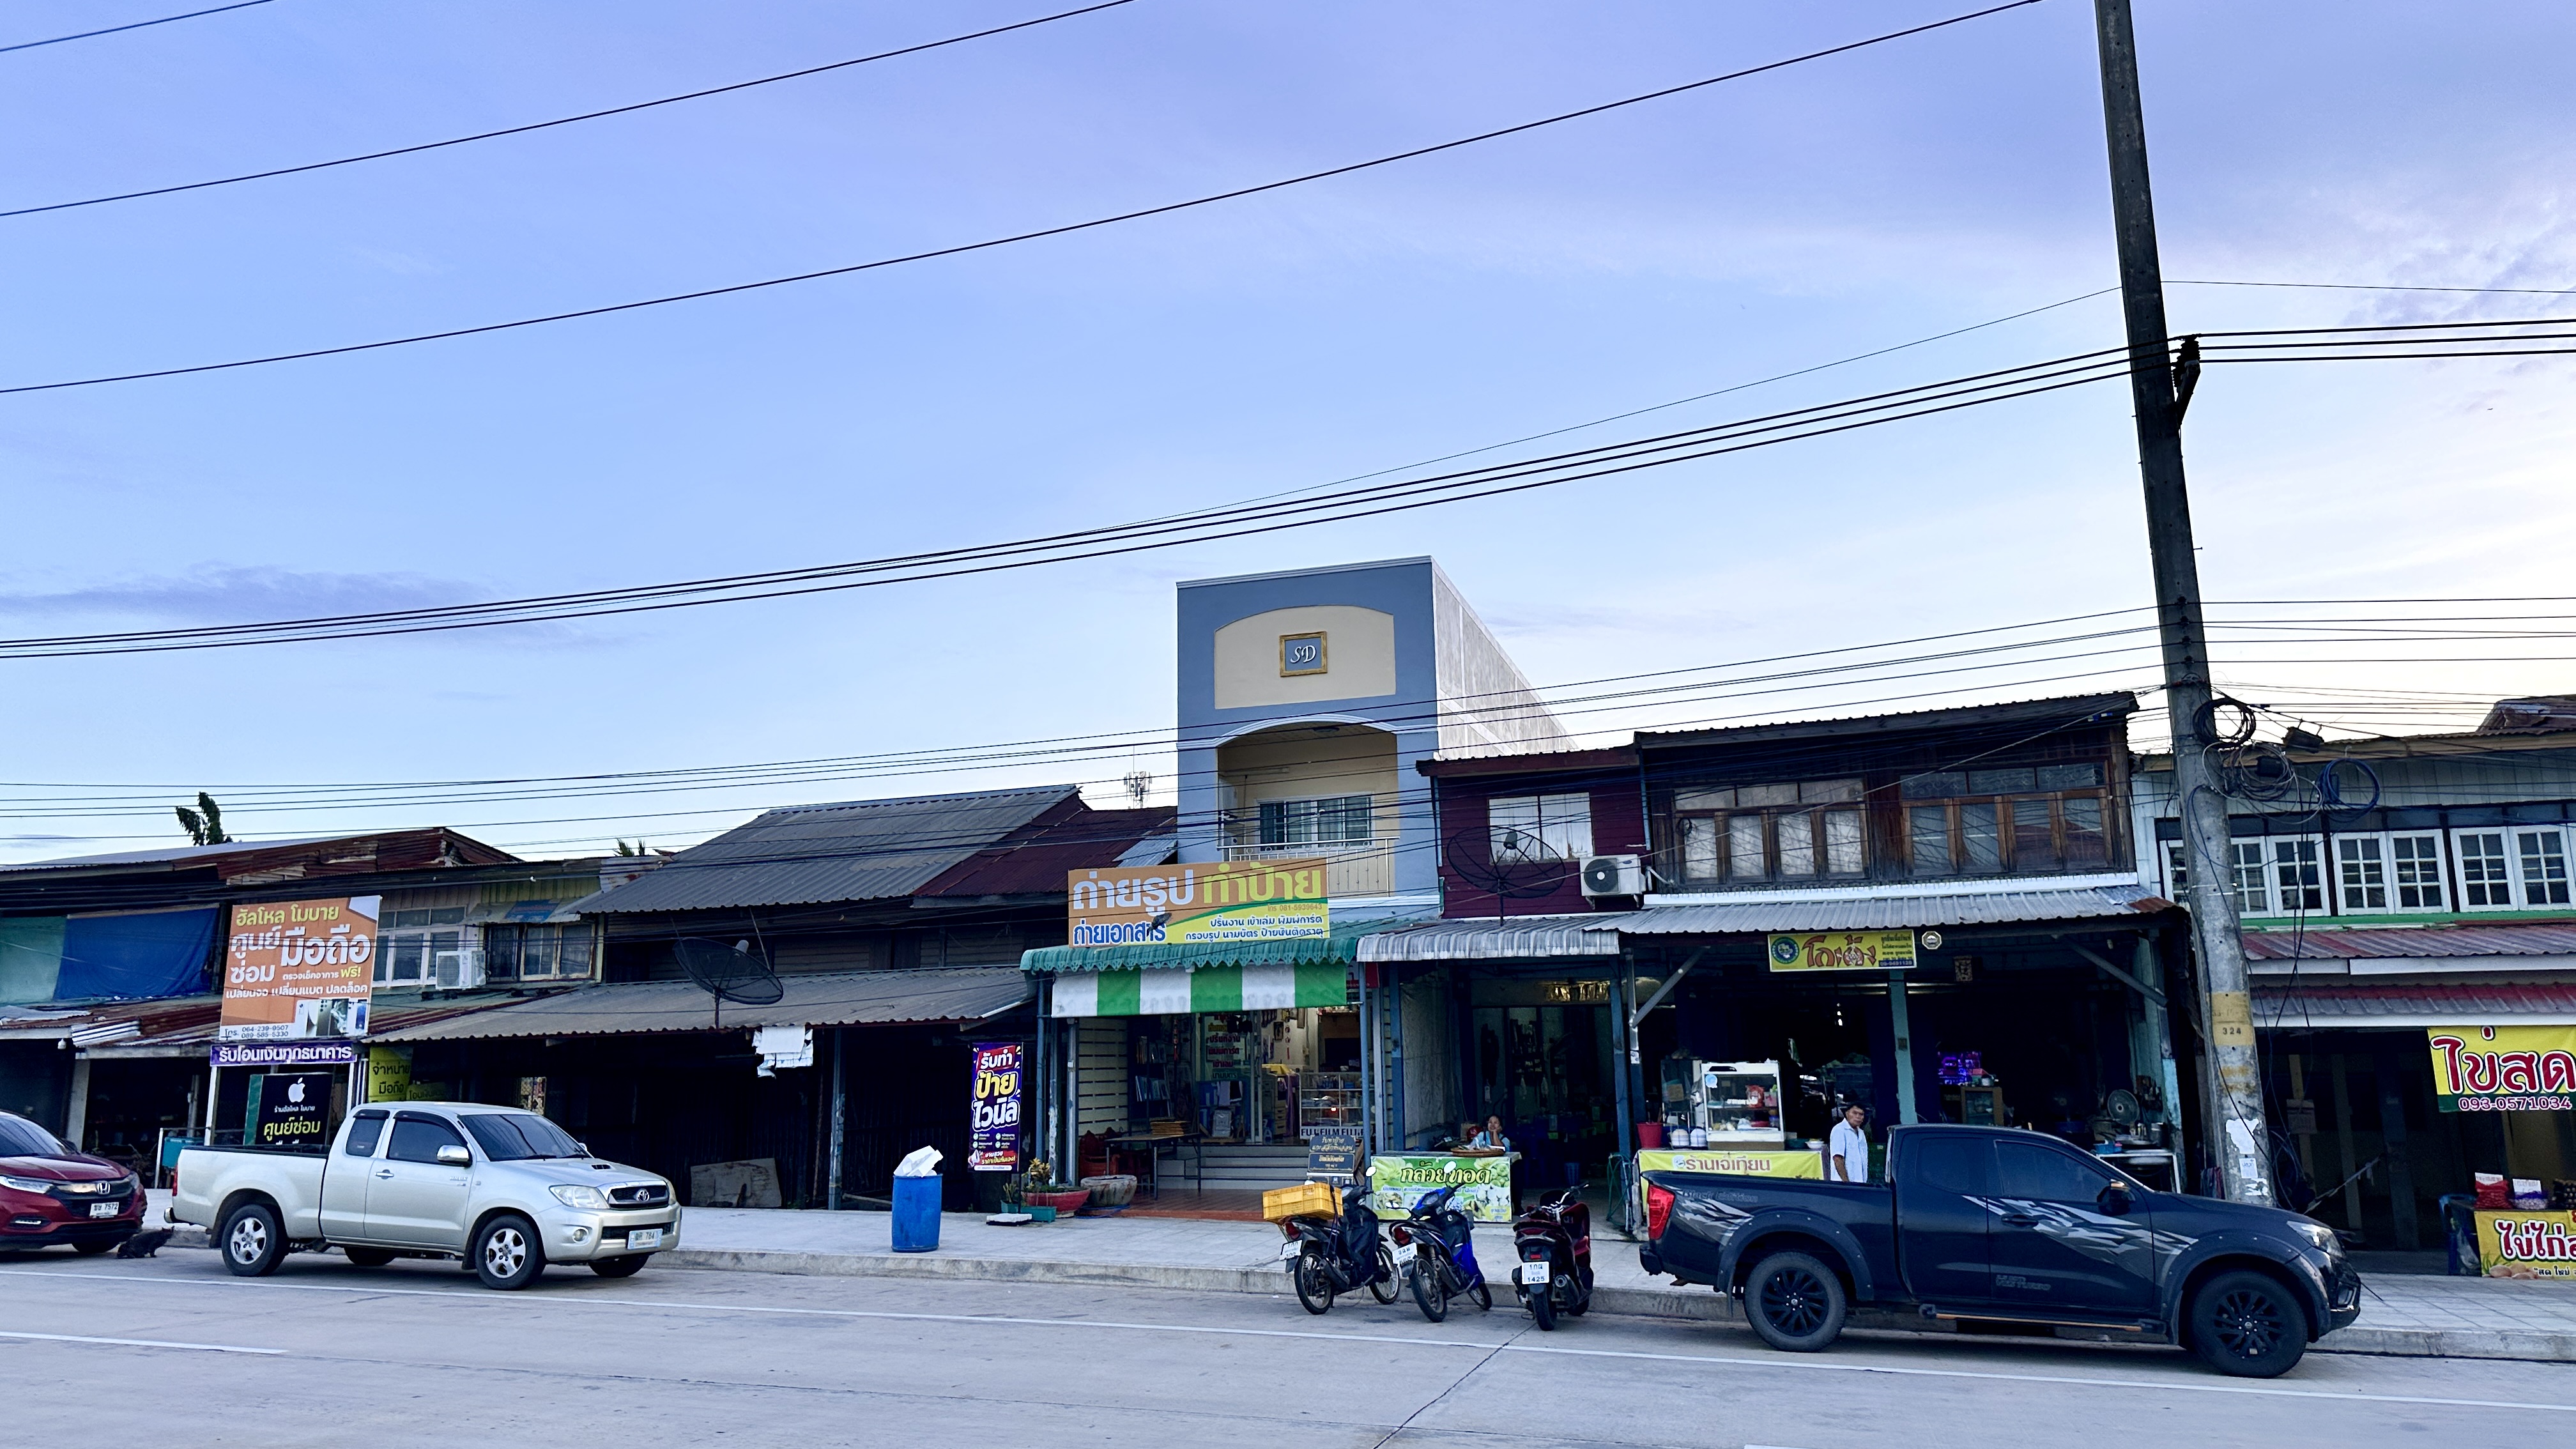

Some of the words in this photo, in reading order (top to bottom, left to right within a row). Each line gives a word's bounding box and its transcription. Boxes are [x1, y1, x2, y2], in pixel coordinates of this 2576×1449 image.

[1290, 645, 1316, 663] SD
[1073, 869, 1193, 917] ถ่ายรูป
[1203, 862, 1322, 904] ทำป้าย
[236, 906, 285, 926] ฮัลโหล
[291, 903, 339, 922] โมบาย
[1211, 915, 1245, 927] ปริ้นงาน
[1247, 915, 1275, 926] เข้าเล่ม
[1278, 914, 1322, 924] พิมพ์การ์ด
[1074, 919, 1166, 945] ถ่ายเอกสาร
[1186, 931, 1220, 942] กรอบรูป
[1223, 928, 1258, 938] นามบัตร
[231, 925, 282, 959] ศูนย์
[280, 924, 371, 967] มือถือ
[231, 960, 275, 983] ซ่อม
[282, 970, 339, 980] ตรวจเช็คอาการ
[341, 966, 361, 978] ฟรี!
[272, 983, 323, 996] เปลี่ยนแบต
[326, 981, 368, 994] ปลดล็อค
[219, 1045, 352, 1064] รับโอนเงินทุกธนาคาร
[981, 1048, 1013, 1069] รับทำ
[2431, 1025, 2576, 1092] ไข่สด
[372, 1062, 411, 1075] จำหน่าย
[379, 1080, 404, 1094] มือถือ
[976, 1071, 1016, 1099] ป้าย
[974, 1097, 1018, 1128] ไวนิล
[2460, 1096, 2572, 1110] 093-0571034
[263, 1116, 321, 1142] ศูนย์ซ่อม
[1401, 1161, 1491, 1183] กล้วยทอด
